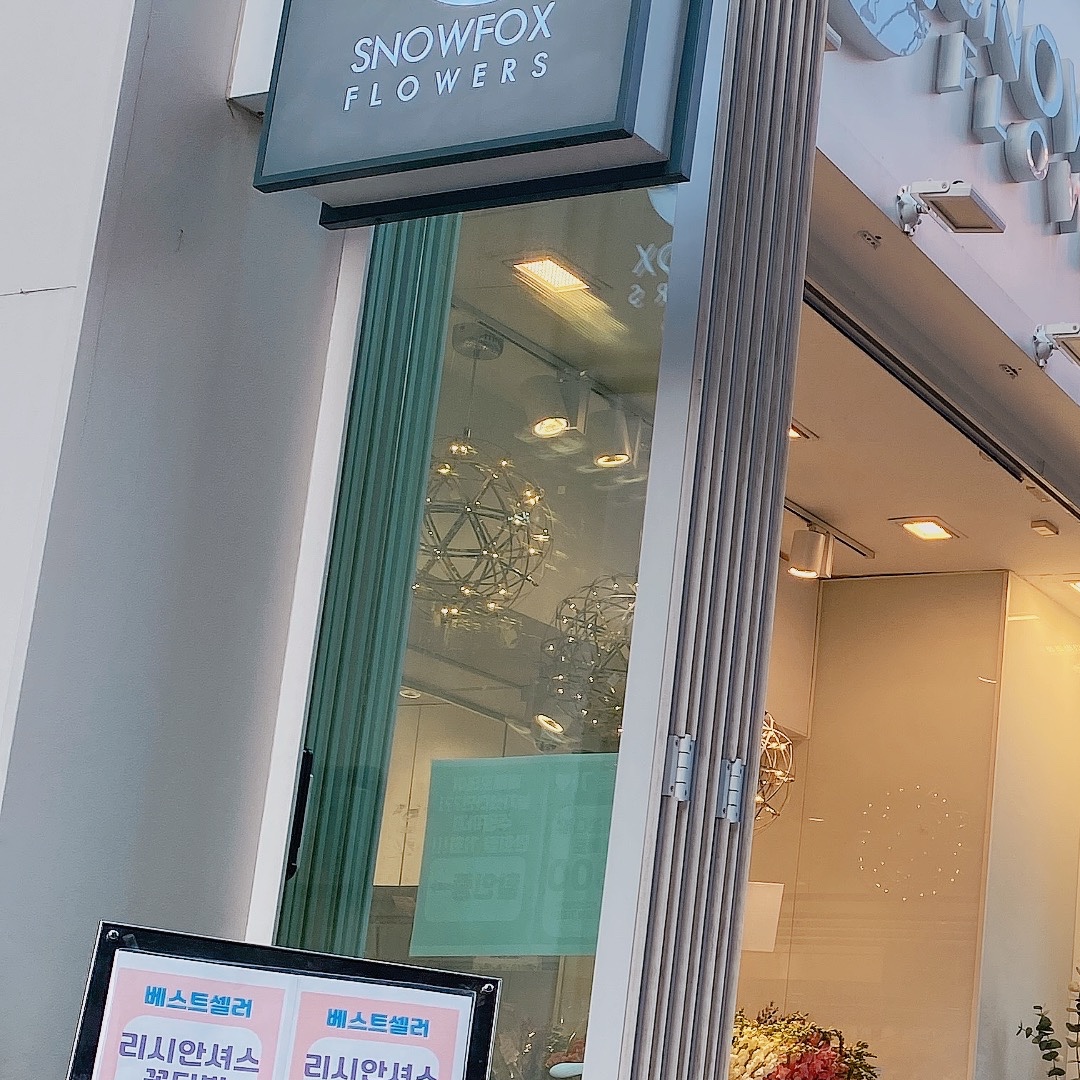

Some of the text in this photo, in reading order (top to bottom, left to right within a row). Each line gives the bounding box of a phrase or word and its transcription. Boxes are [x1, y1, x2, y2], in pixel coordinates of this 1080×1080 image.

[350, 2, 556, 74] SNOWFOX
[342, 52, 549, 112] FLOWERS
[145, 985, 252, 1018] 베스트셀러
[326, 1008, 430, 1038] 베스트셀러
[118, 1032, 260, 1074] 리시안셔스
